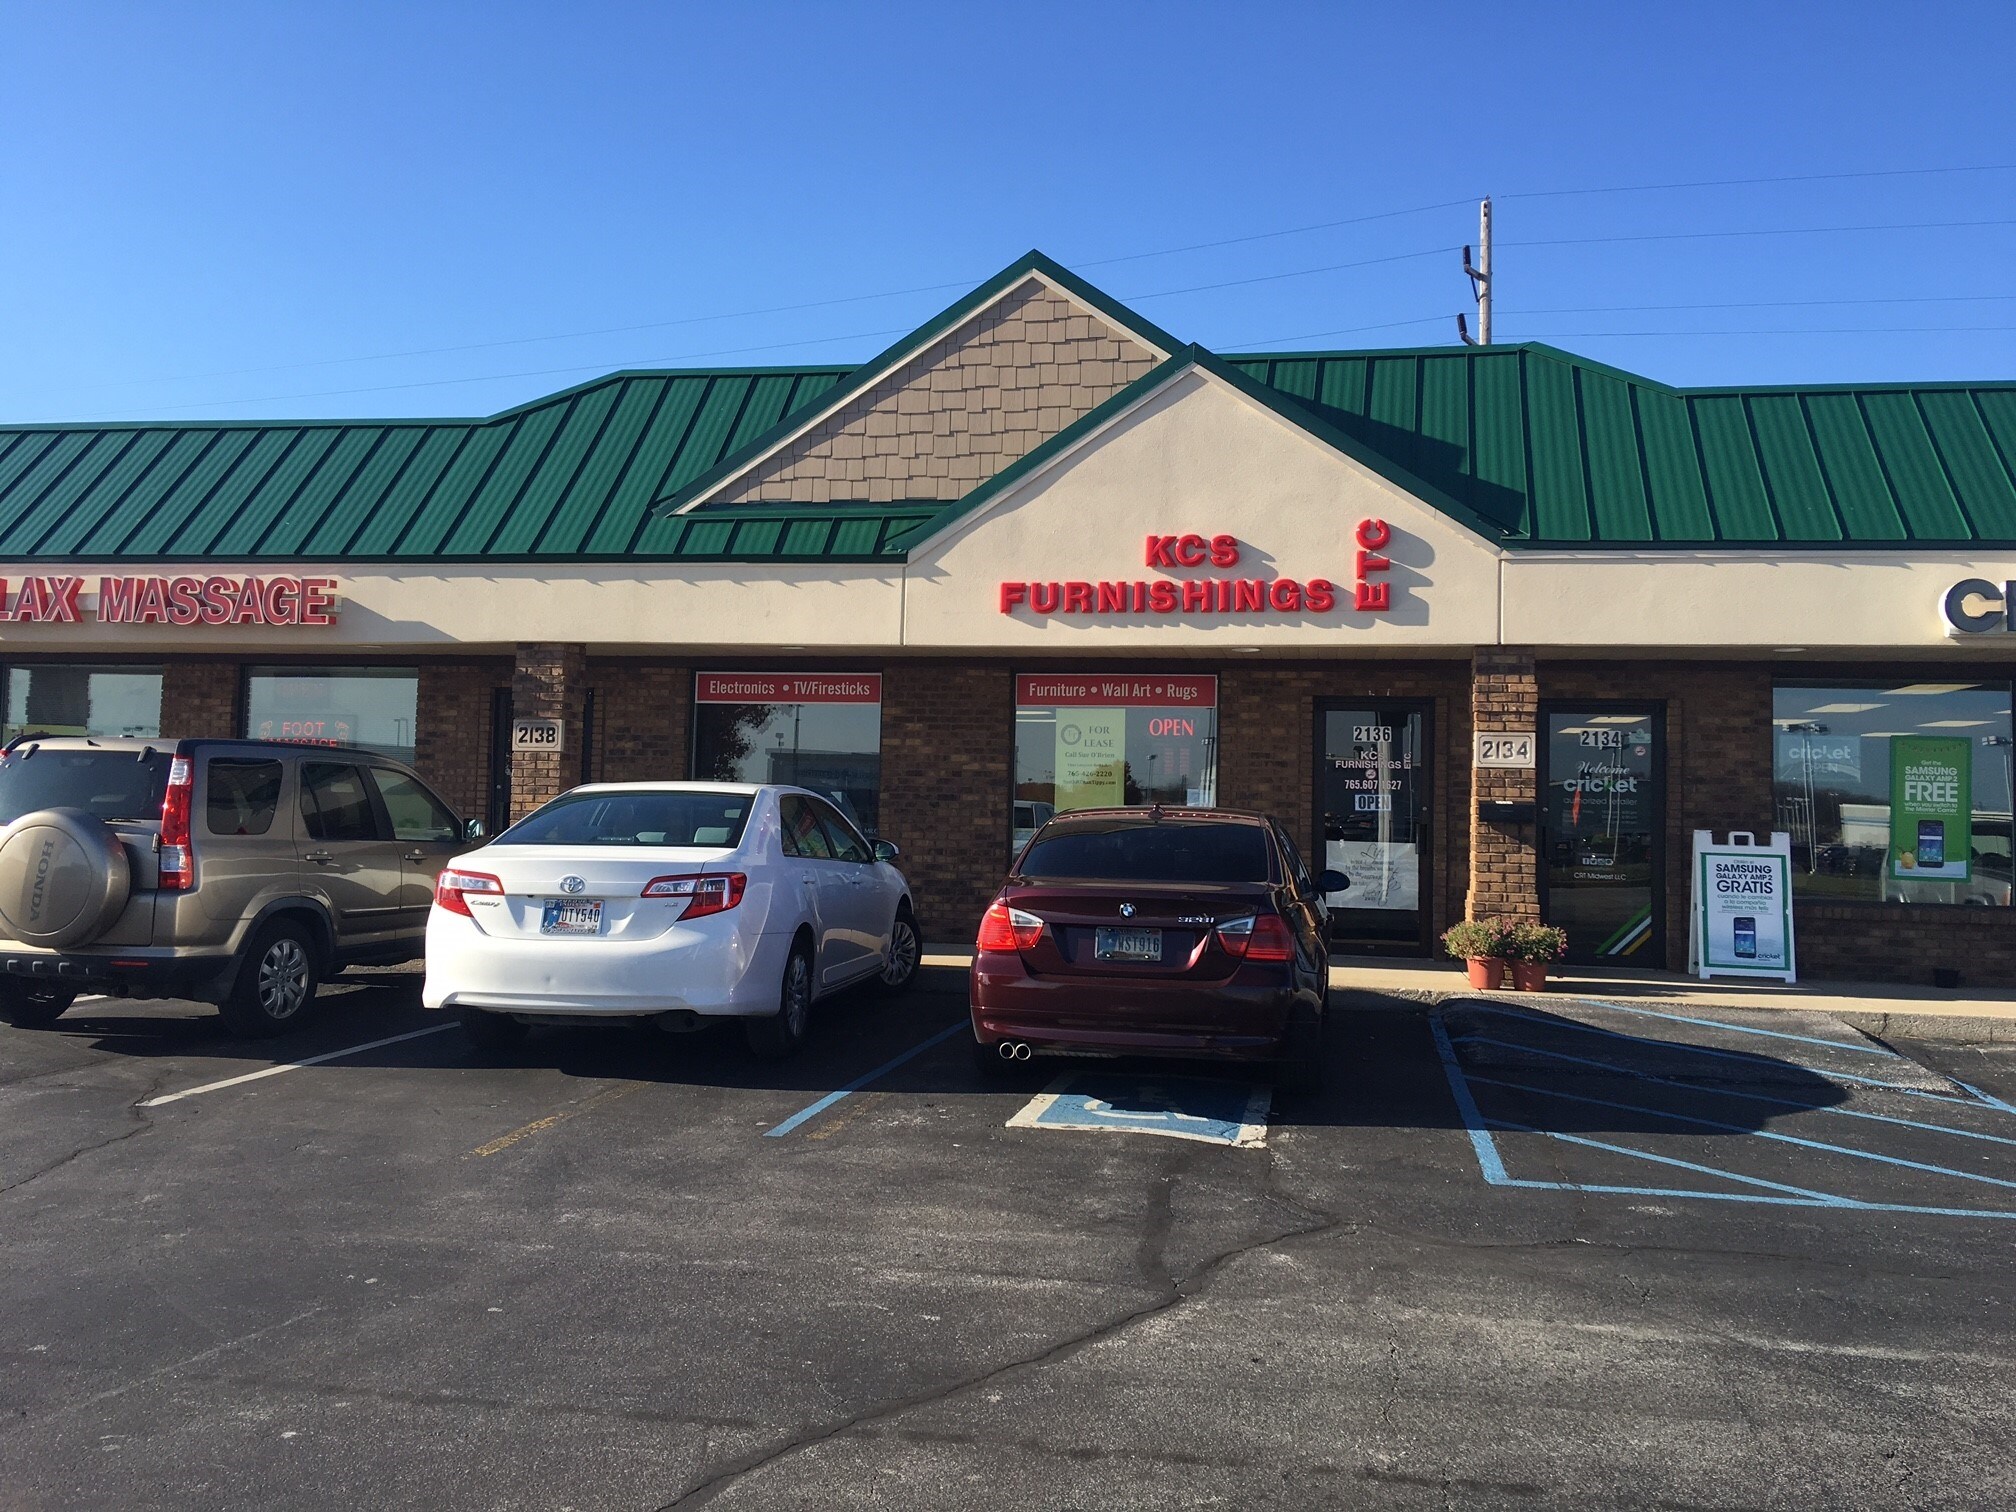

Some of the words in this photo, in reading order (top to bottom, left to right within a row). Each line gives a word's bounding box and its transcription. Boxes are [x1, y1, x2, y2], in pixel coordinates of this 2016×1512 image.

[1146, 534, 1239, 567] KCS
[1356, 518, 1391, 611] ETC
[97, 577, 337, 625] MASSAGE
[1000, 578, 1335, 614] FURNISHINGS
[1945, 578, 2016, 632] C
[710, 681, 775, 694] Electronics
[794, 681, 870, 695] TV/Firesticks
[1029, 683, 1086, 697] Furniture
[1102, 683, 1128, 697] Wall
[1132, 684, 1151, 697] Art
[1167, 684, 1198, 700] Rugs
[282, 721, 325, 736] FOOT
[518, 726, 556, 743] 2138
[1089, 726, 1110, 734] FOR
[1149, 719, 1194, 736] OPEN
[1354, 727, 1390, 741] 2136
[1084, 739, 1113, 748] LEASE
[1581, 730, 1620, 746] 2134
[1482, 741, 1528, 759] 2134
[1788, 745, 1851, 759] cricket
[1335, 760, 1402, 769] FURNISHNGS
[1577, 761, 1630, 774] Welcome
[1905, 766, 1957, 776] SAMSUNG
[1563, 776, 1638, 792] cricket
[1905, 781, 1958, 802] FREE
[1358, 796, 1390, 809] OPEN
[1716, 863, 1772, 874] SAMSUNG
[30, 840, 55, 920] HONDA
[1716, 880, 1773, 894] GRATIS
[561, 908, 601, 922] UTY540
